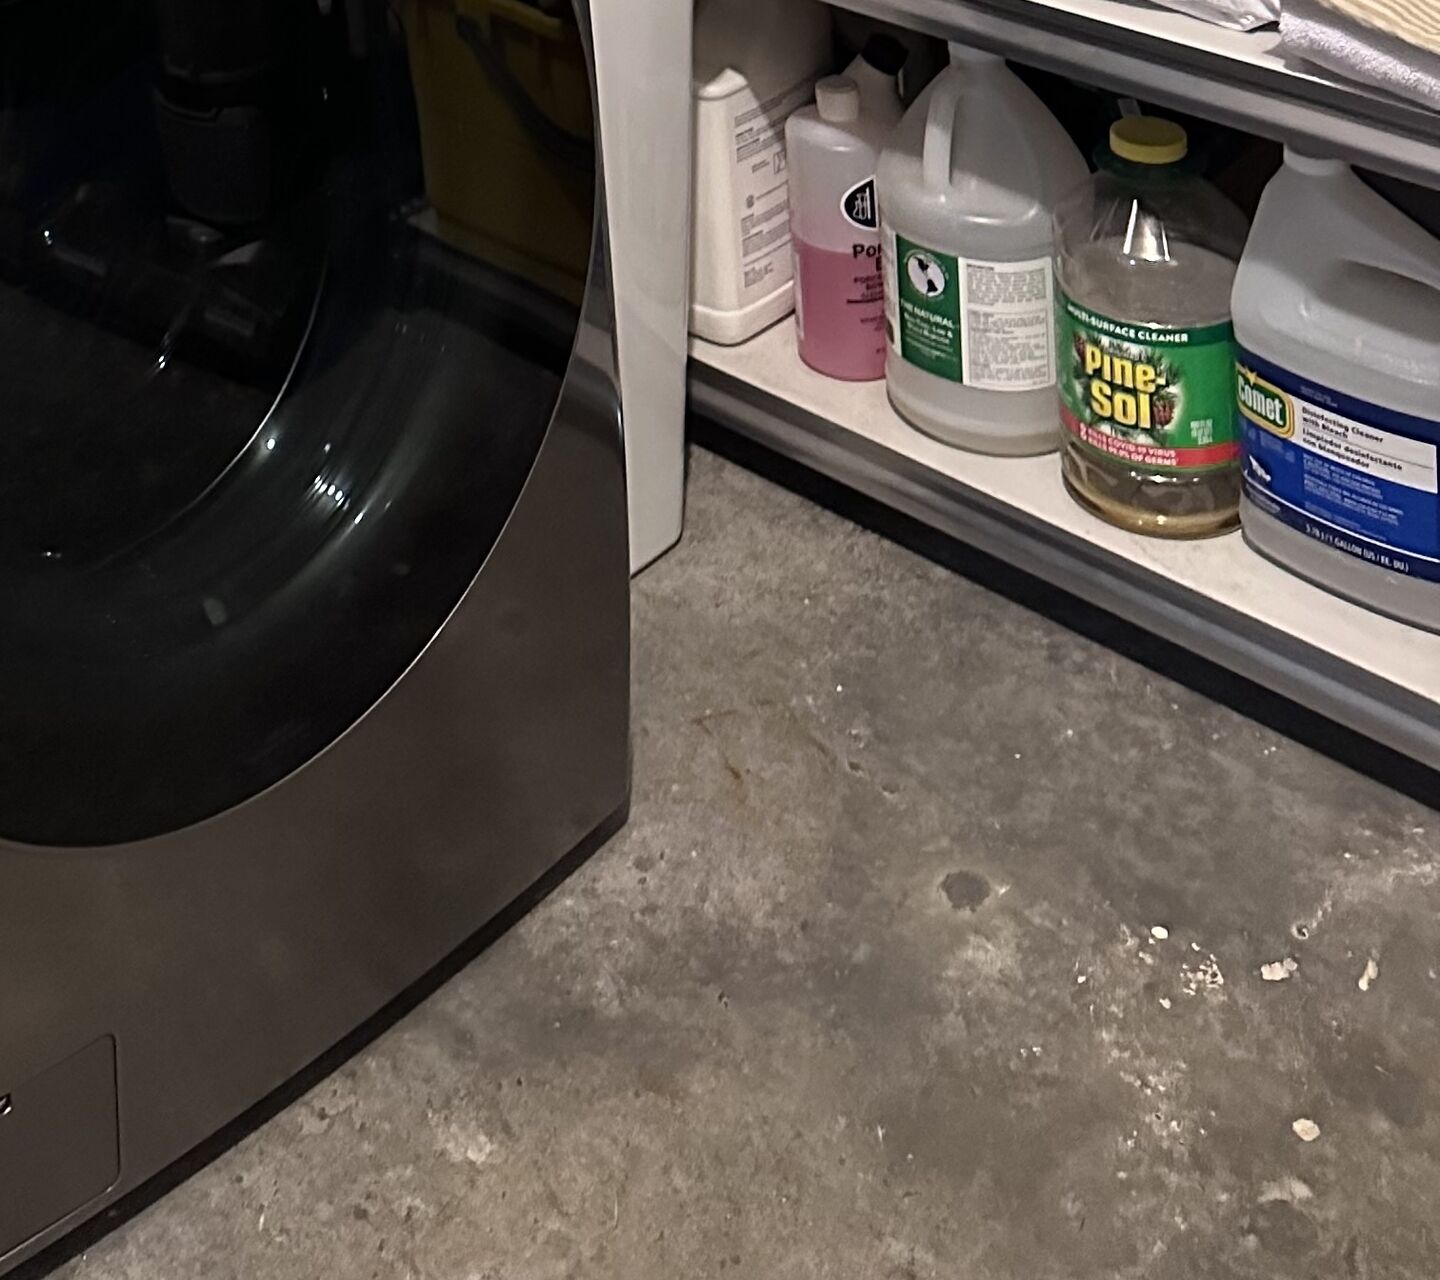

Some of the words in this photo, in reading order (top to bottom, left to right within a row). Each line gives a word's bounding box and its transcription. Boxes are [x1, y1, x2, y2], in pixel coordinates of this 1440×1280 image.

[1137, 333, 1189, 343] CLEANER
[1084, 342, 1167, 394] Pine-
[1090, 378, 1151, 429] Sol
[1237, 374, 1284, 426] Comet
[1302, 405, 1349, 433] Disinfecting
[1351, 426, 1384, 443] Cleaner
[1302, 416, 1320, 428] with
[1321, 423, 1348, 439] Bleach
[1334, 537, 1362, 556] GALLON
